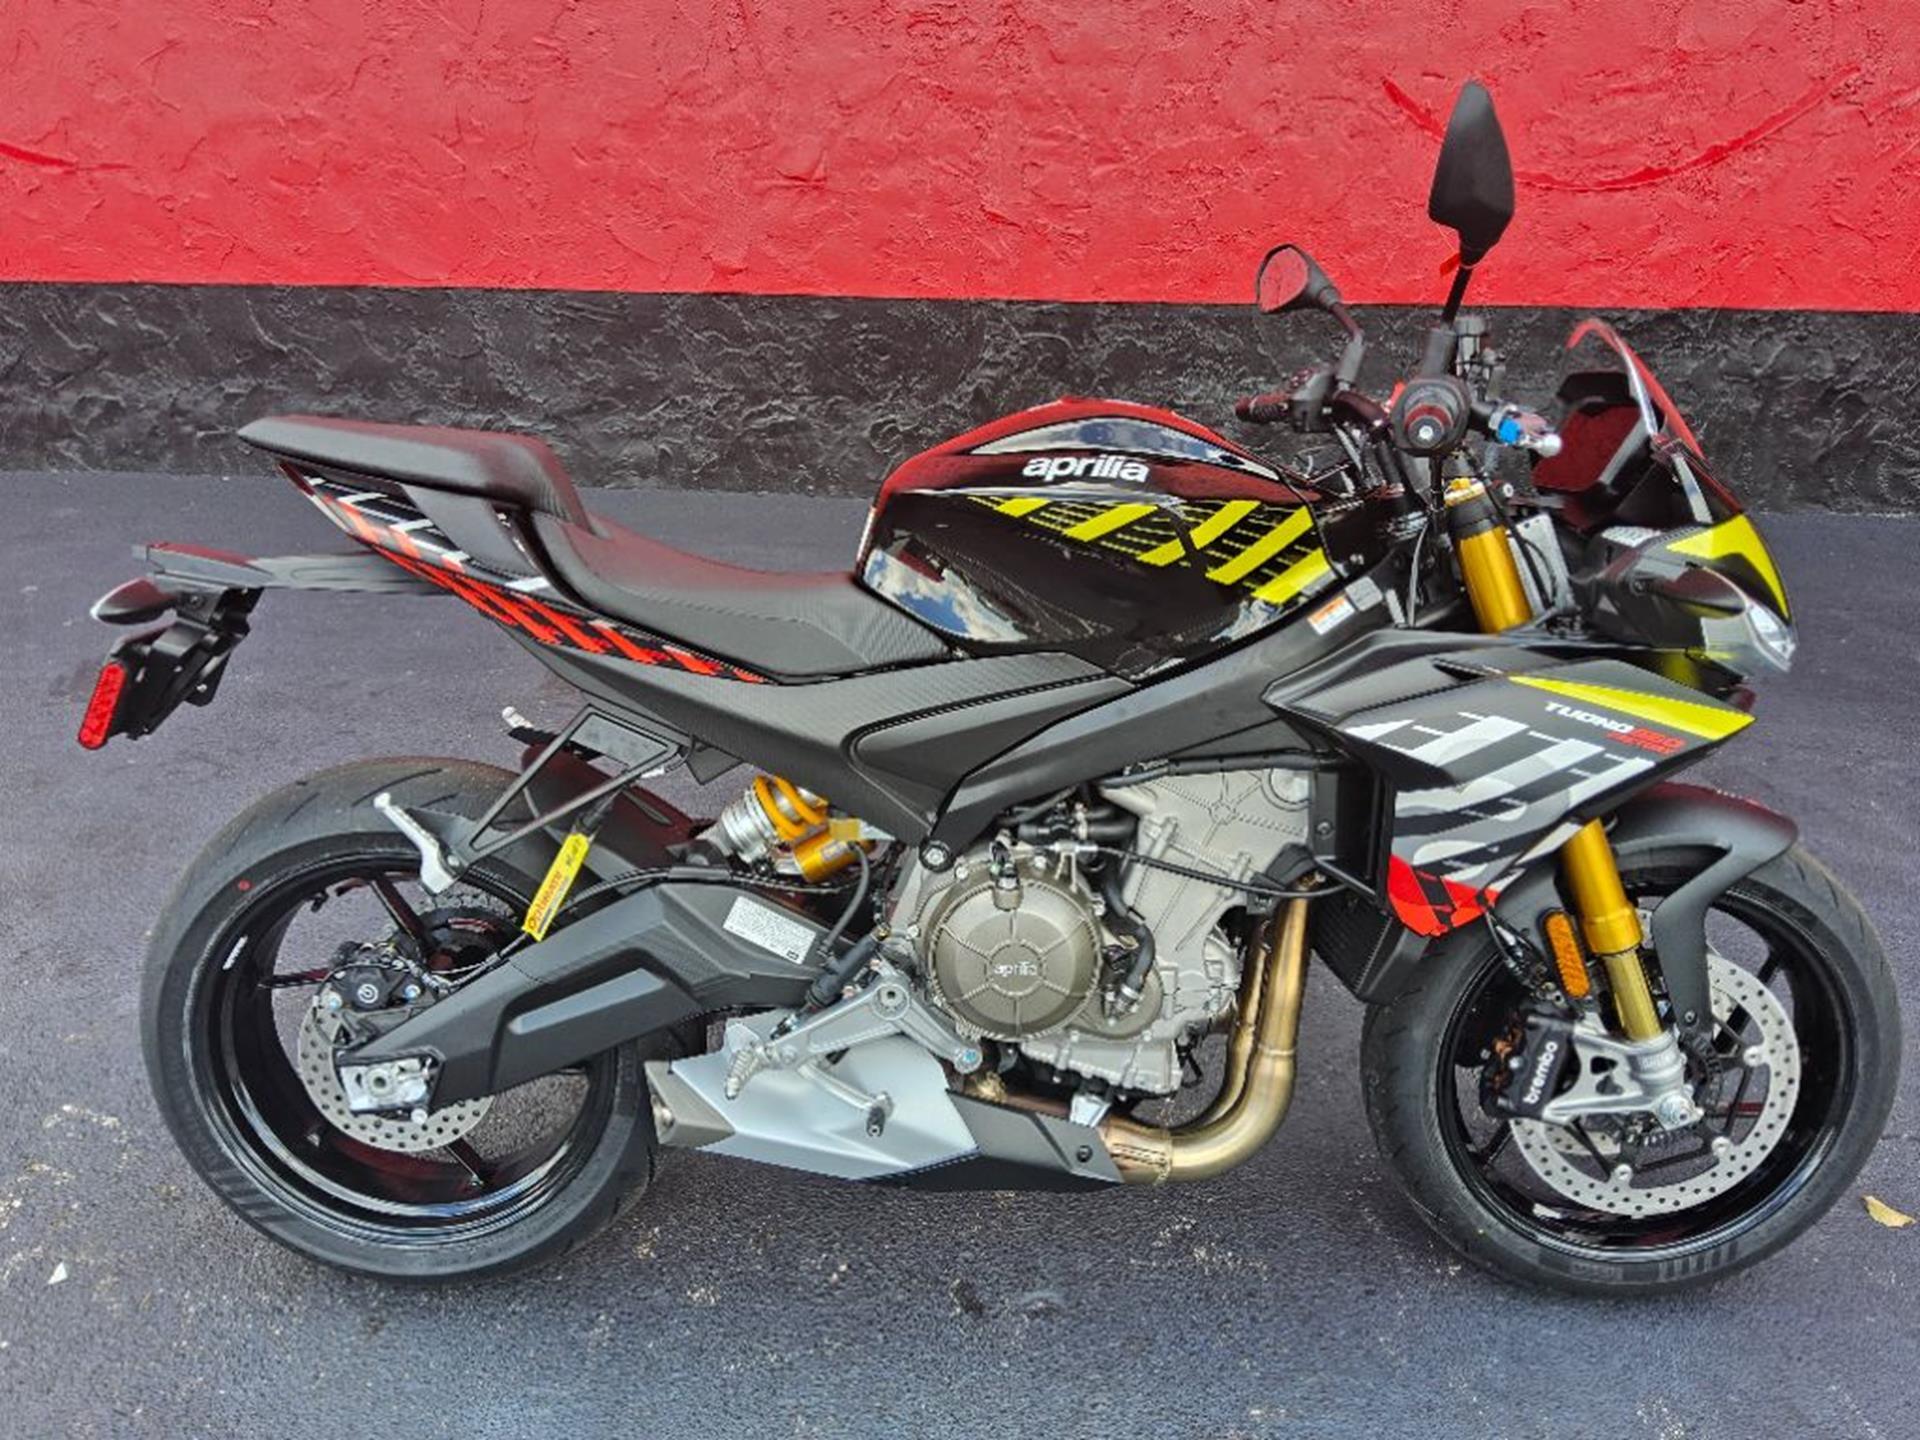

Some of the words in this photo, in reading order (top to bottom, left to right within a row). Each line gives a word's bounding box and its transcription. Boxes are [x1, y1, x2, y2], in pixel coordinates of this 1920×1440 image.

[1021, 453, 1150, 482] aprilia
[1545, 701, 1635, 734] TUONO
[1523, 1041, 1558, 1104] brembo
